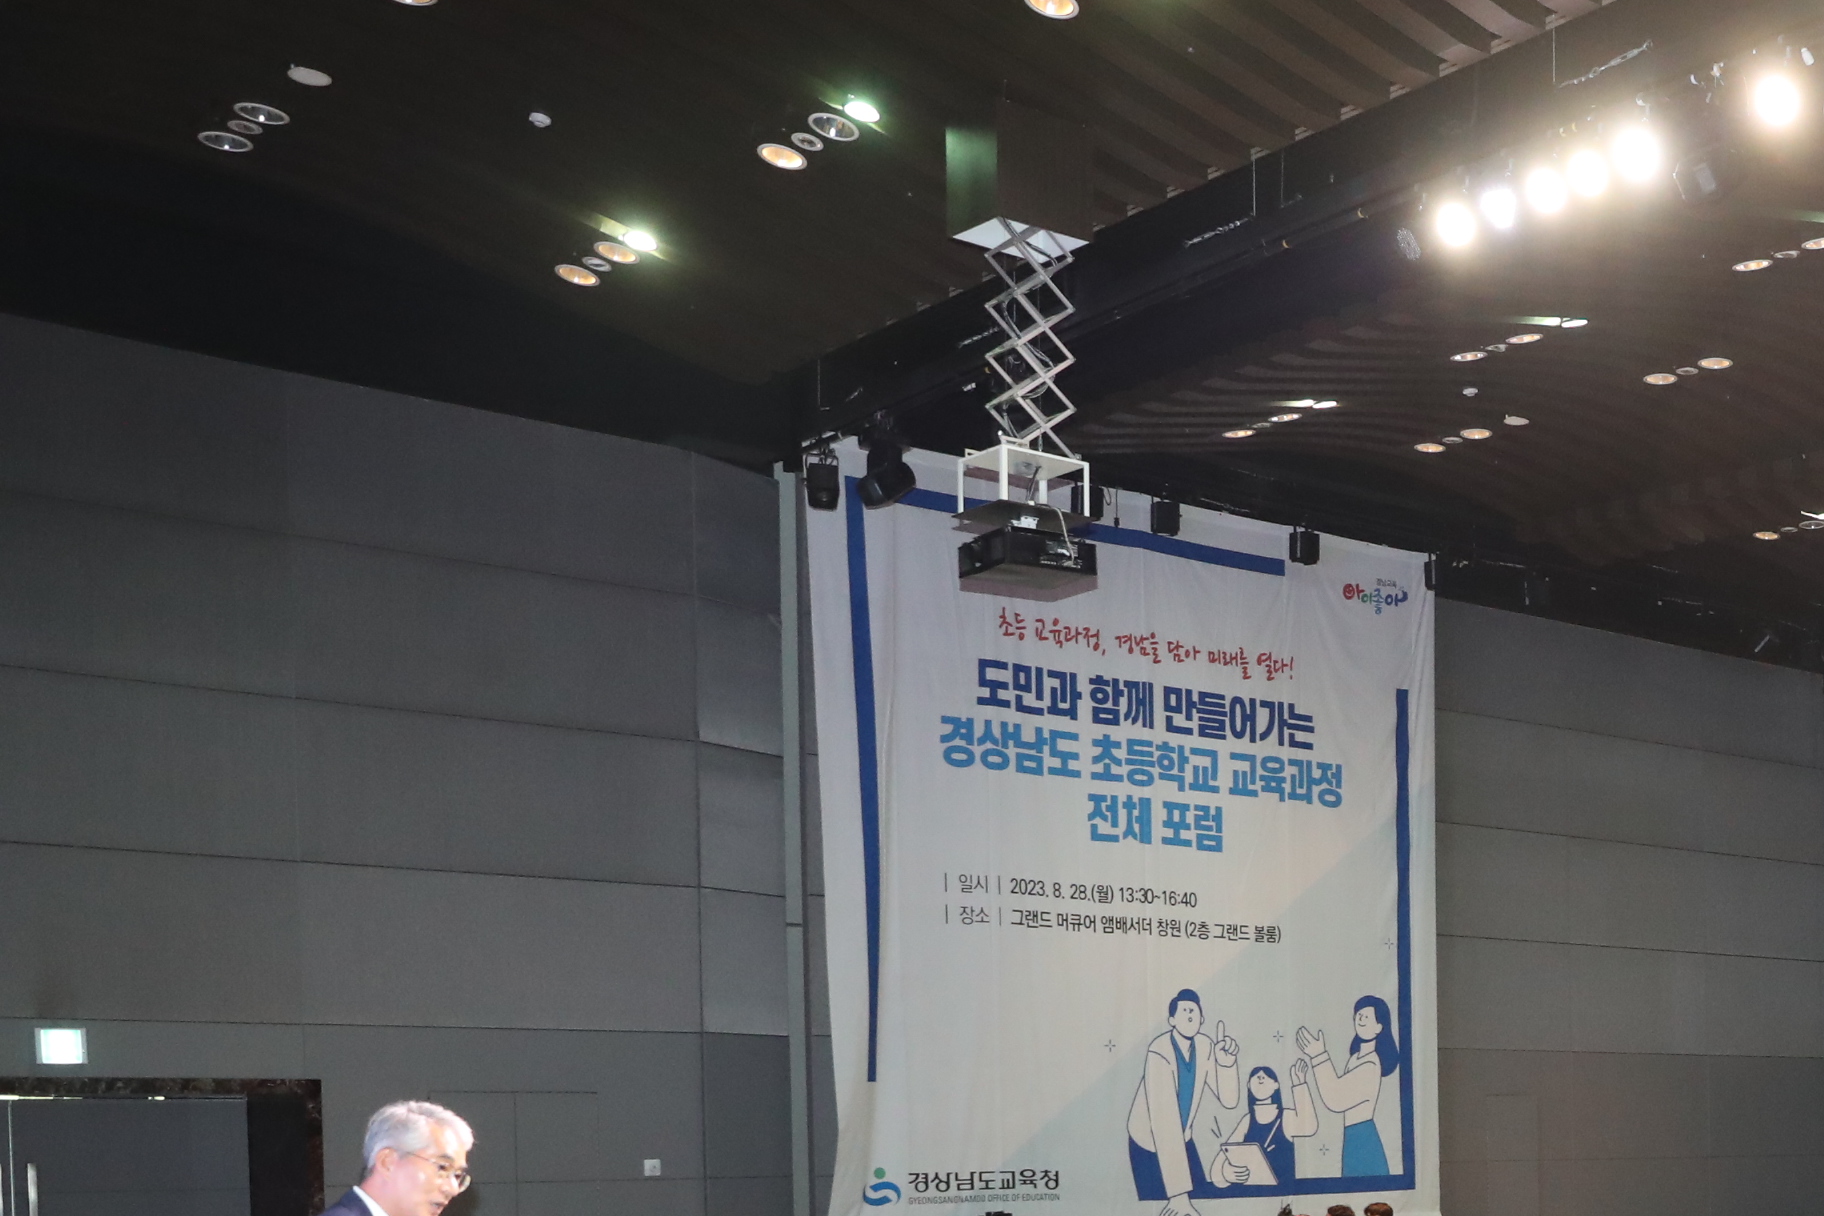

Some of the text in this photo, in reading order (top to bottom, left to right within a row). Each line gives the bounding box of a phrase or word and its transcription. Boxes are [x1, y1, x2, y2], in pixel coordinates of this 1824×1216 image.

[998, 607, 1295, 681] 초등 교육과정, 경남을 담아 미래를 열다!
[976, 658, 1315, 751] 도민과 함께 만들어가는
[939, 715, 1343, 809] 경상남도 초등학교 교육과정
[1087, 793, 1223, 853] 전체 포럼
[959, 874, 1197, 908] 일시 2023. 8. 28.(월) 13:30~16:40
[959, 906, 1282, 944] 장소 그랜드 머큐어 앰배서더 창원 (2층 그랜드 볼룸)
[908, 1168, 1060, 1193] 경상남도교육청
[987, 1194, 1010, 1202] OFFICE
[1012, 1193, 1021, 1202] OF
[1022, 1193, 1061, 1202] EDUCATION
